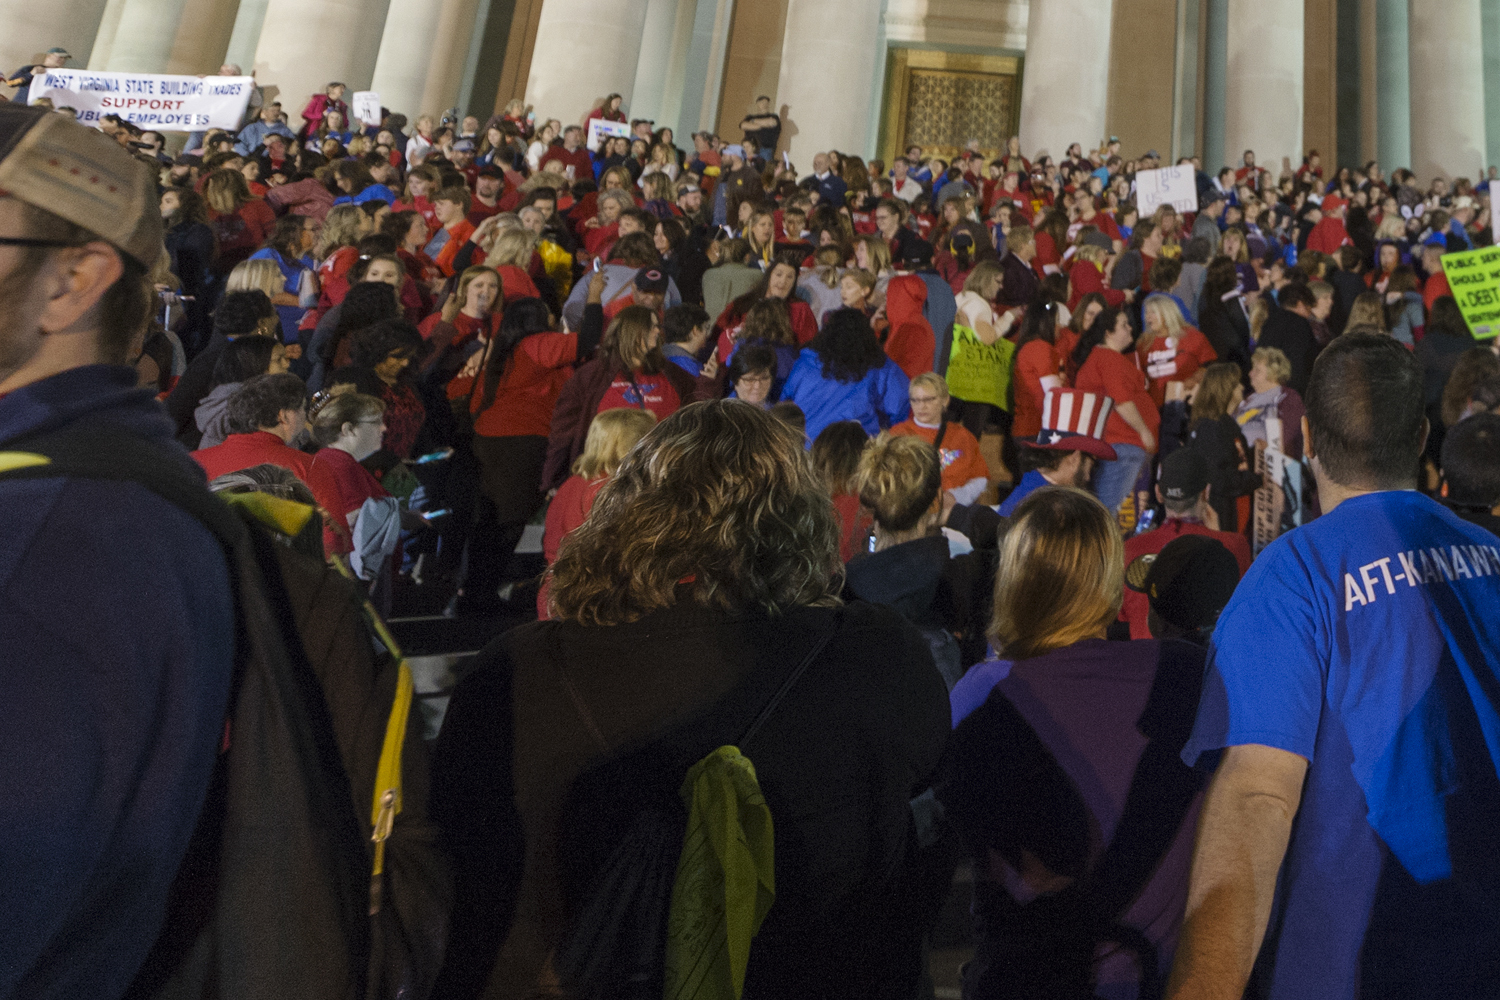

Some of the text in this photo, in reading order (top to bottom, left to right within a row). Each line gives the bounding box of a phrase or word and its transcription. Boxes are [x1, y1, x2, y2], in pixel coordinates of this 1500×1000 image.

[44, 73, 73, 88] WEST
[125, 79, 154, 94] STATE
[160, 80, 203, 95] BUILDING
[208, 83, 242, 95] TRADES
[101, 96, 185, 110] SUPPORT
[127, 112, 210, 125] EMPLOYEES
[1445, 257, 1477, 270] PUBLIC
[1451, 272, 1486, 286] SHOULD
[1467, 286, 1500, 307] DEBT
